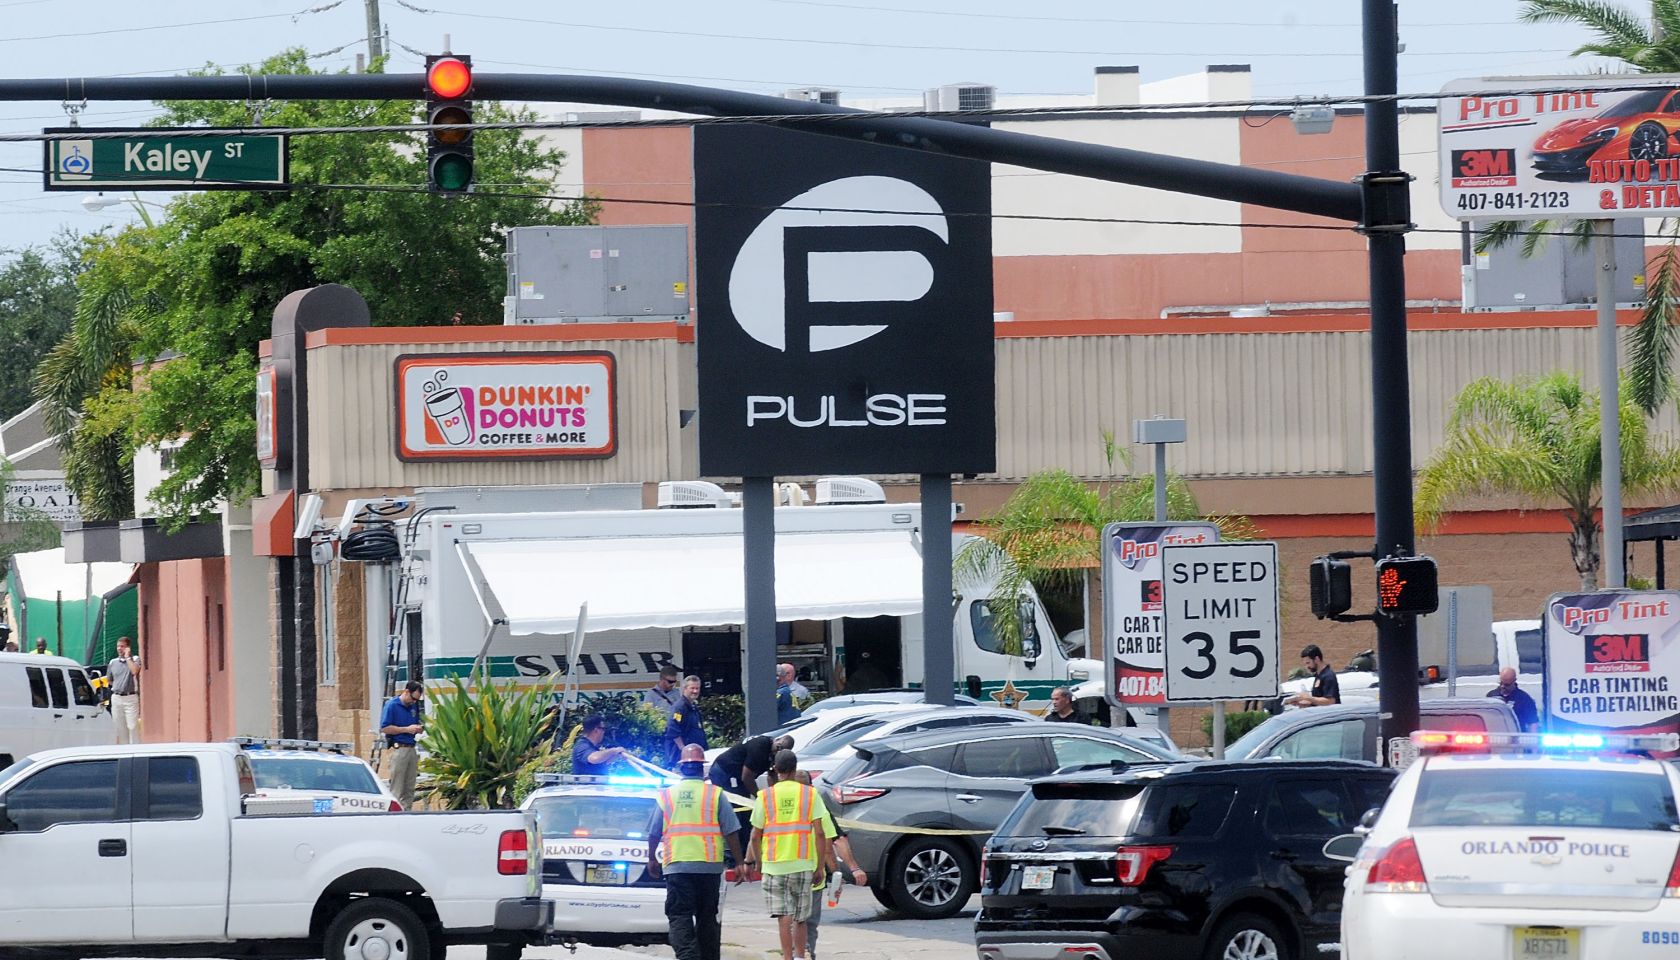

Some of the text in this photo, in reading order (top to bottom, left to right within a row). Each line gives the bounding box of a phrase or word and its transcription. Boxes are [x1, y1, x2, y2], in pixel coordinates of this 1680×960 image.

[1459, 91, 1600, 121] Pro Tint
[124, 142, 244, 178] Kaley ST
[1460, 150, 1509, 177] 3M
[1589, 158, 1680, 184] AUTO TI
[1457, 191, 1569, 210] 407-841-2123
[1599, 188, 1618, 210] &
[479, 385, 590, 407] DUNKIN'
[479, 407, 586, 428] DONUTS
[746, 393, 947, 428] PULSE
[479, 432, 586, 445] COFFEE & MORE
[5, 484, 32, 495] Orange
[34, 483, 62, 493] Avenue
[1122, 541, 1158, 560] Pro
[1172, 561, 1267, 584] SPEED
[1184, 598, 1257, 620] LIMIT
[1564, 600, 1669, 627] Pro Tint
[1124, 616, 1149, 633] CAR
[1117, 636, 1143, 654] CAR
[1181, 630, 1265, 680] 35
[1593, 635, 1642, 663] 3M
[1568, 676, 1668, 694] CAR TINTING
[1560, 695, 1678, 713] CAR DETAILING
[341, 797, 386, 810] POLICE
[545, 845, 593, 856] RLANDO
[1461, 841, 1630, 858] ORLANDO POLICE
[1642, 931, 1679, 944] 8090
